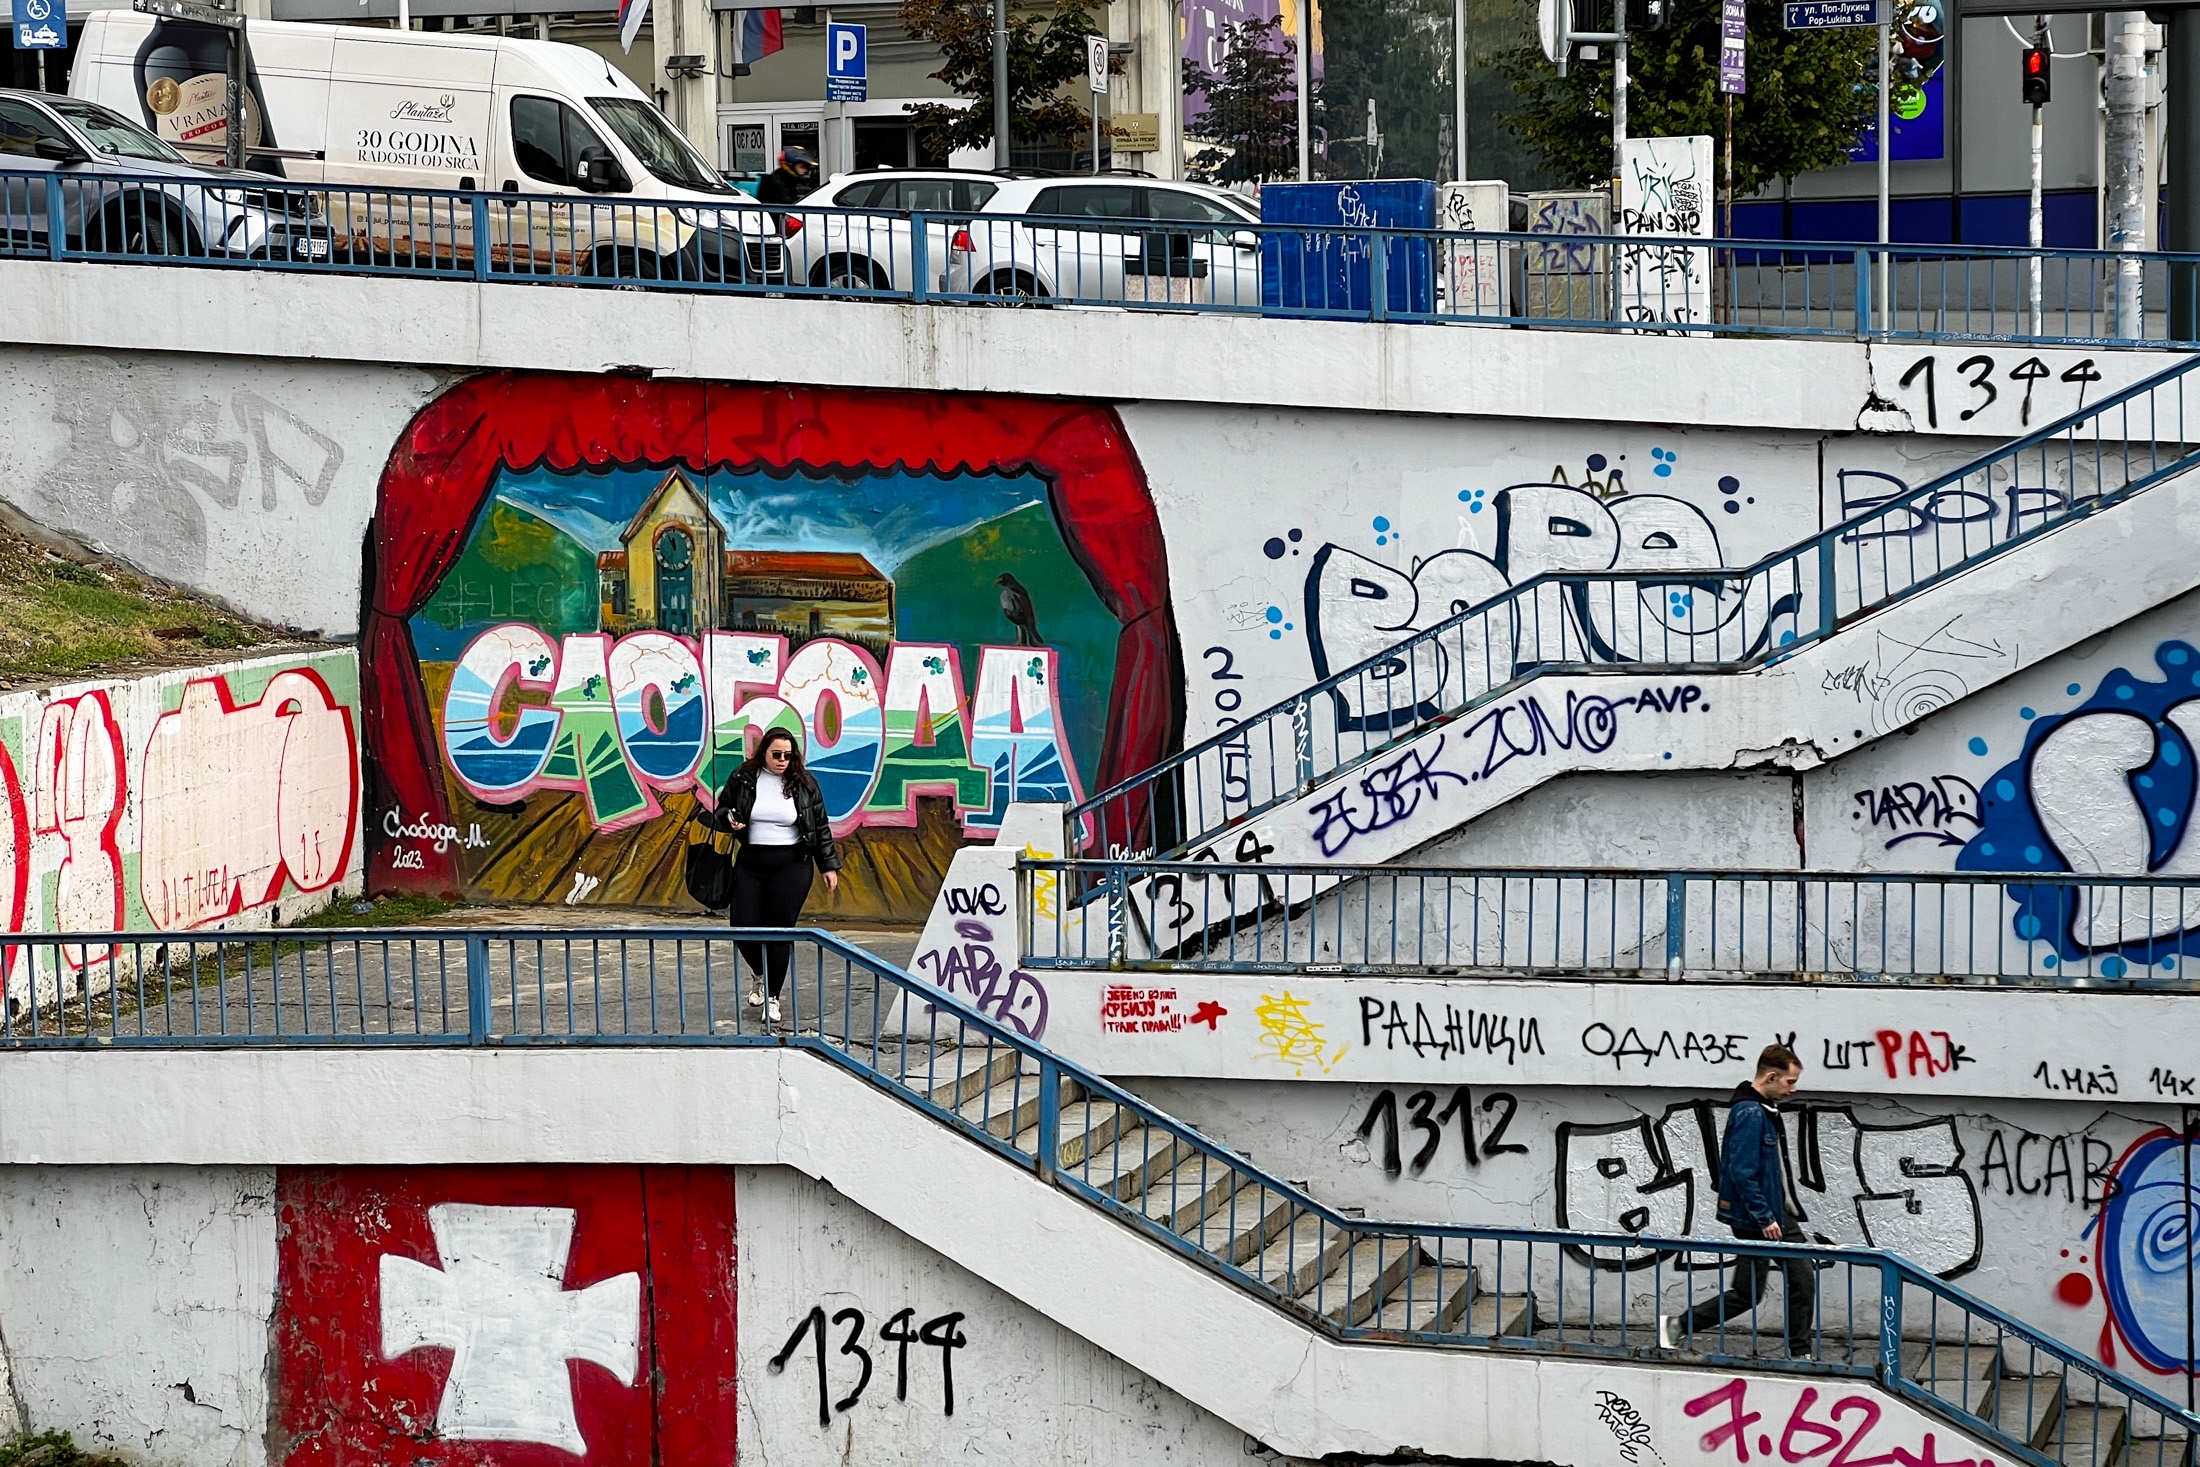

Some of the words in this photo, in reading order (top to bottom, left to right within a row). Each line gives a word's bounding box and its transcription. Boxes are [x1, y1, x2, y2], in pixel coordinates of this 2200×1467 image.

[1804, 6, 1817, 16] ул.
[1821, 3, 1870, 13] Поп-Лукина
[1808, 15, 1852, 26] Pop-Lukina
[1855, 15, 1866, 23] St.
[836, 30, 858, 71] P
[169, 102, 228, 132] VRANA
[204, 121, 227, 132] COR
[357, 129, 382, 148] 30
[388, 130, 478, 156] GODINA
[358, 149, 417, 165] RADOSTI
[421, 154, 442, 167] OD
[445, 156, 479, 170] SRCA
[443, 622, 1093, 850] СЛОБОДА
[1106, 1000, 1156, 1017] СРБИЈУ
[1358, 996, 1545, 1065] РАДНИЦИ
[1581, 1022, 1749, 1070] ОДЛАЗЕ
[1357, 1086, 1529, 1180] 1312
[1980, 1129, 2122, 1210] ACAB
